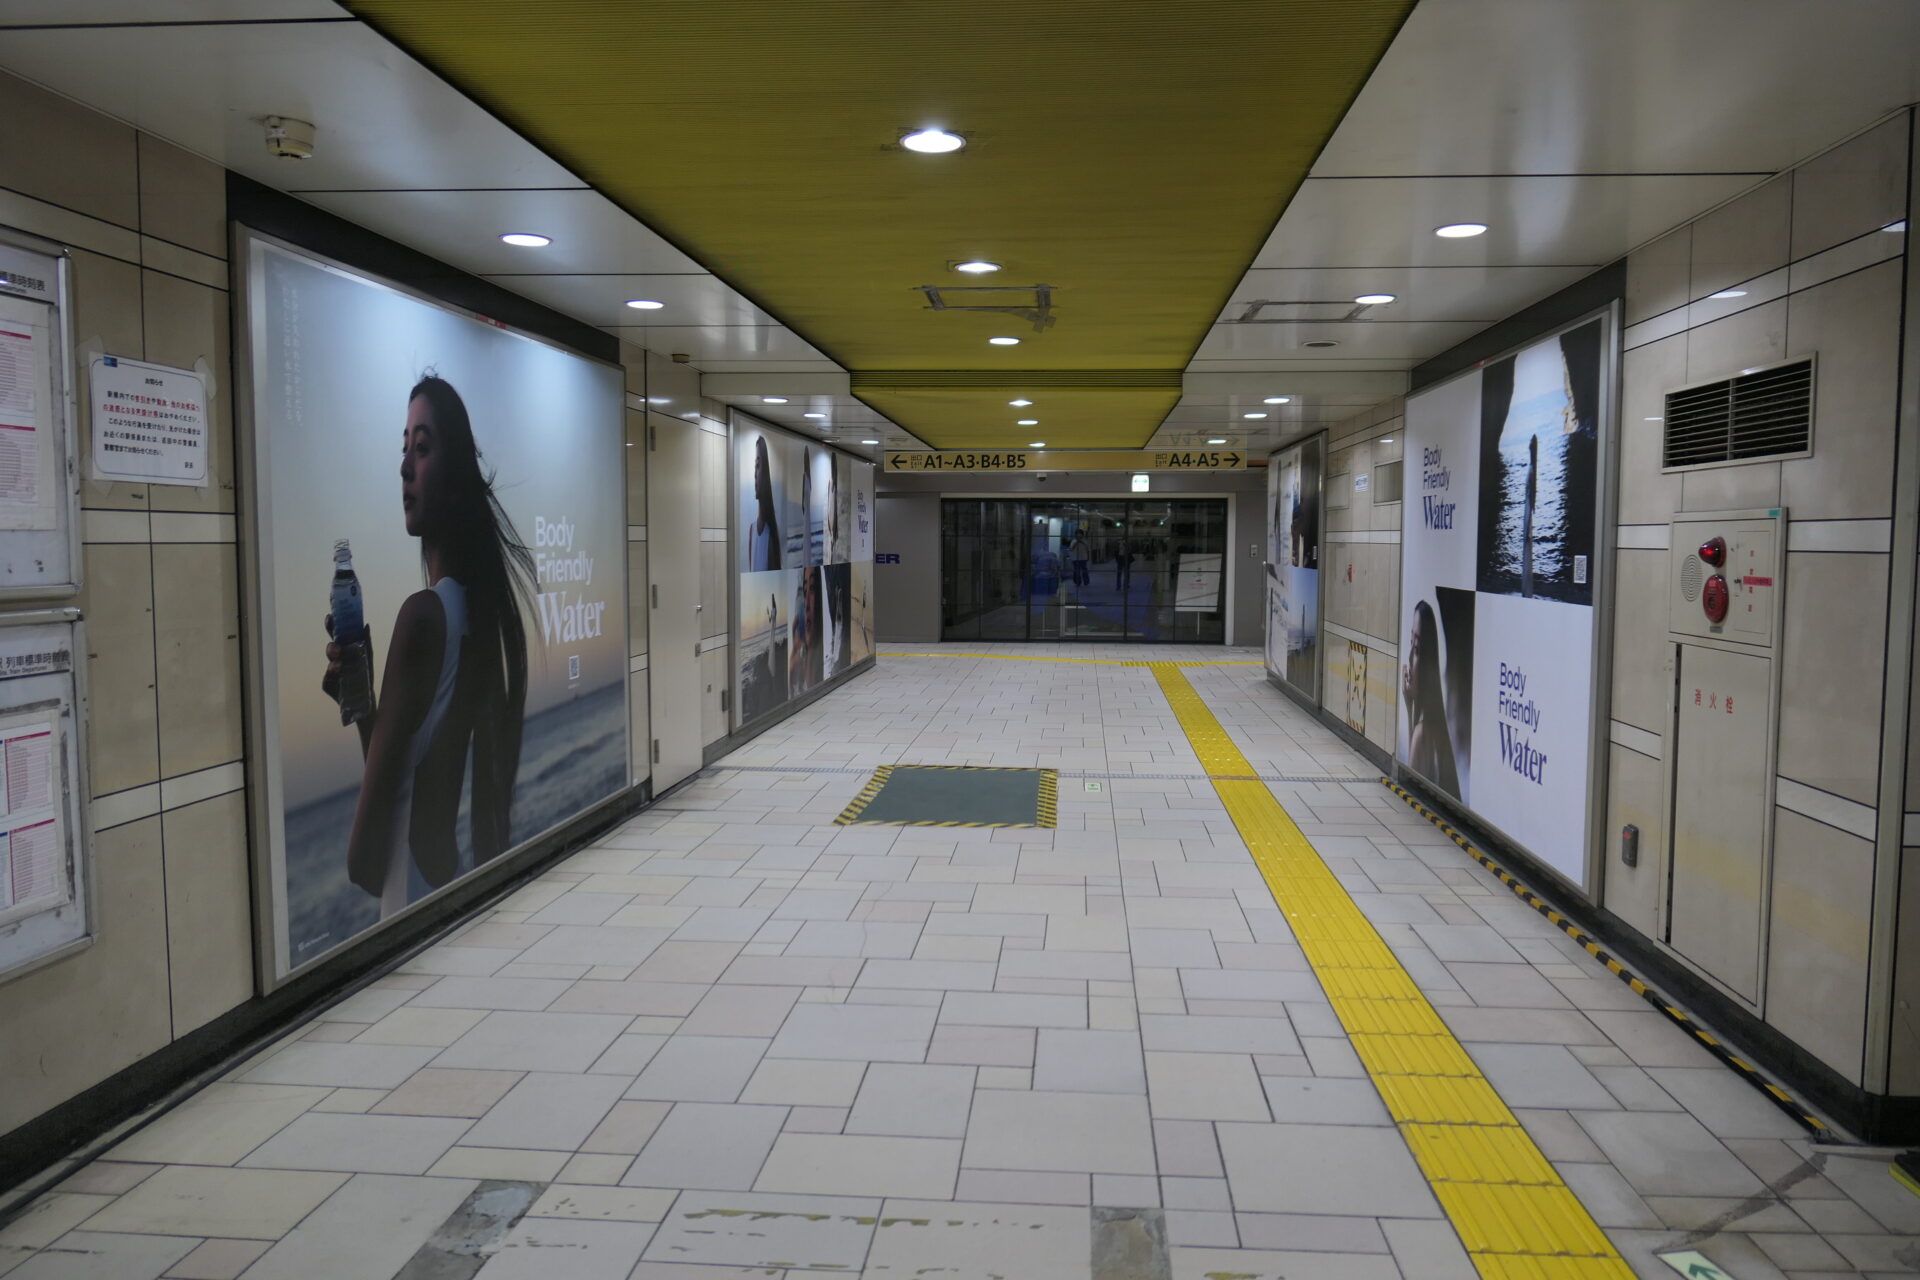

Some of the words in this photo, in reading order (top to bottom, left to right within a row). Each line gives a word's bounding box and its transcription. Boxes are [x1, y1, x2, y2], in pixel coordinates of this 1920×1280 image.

[1423, 447, 1442, 468] Body
[1423, 469, 1450, 492] Friendly
[1423, 495, 1456, 530] Water
[535, 515, 575, 552] Body
[535, 551, 594, 585] Friendly
[536, 591, 605, 648] Water
[1500, 662, 1527, 693] Body
[1499, 691, 1541, 734] Friendly
[1498, 721, 1548, 787] Water
